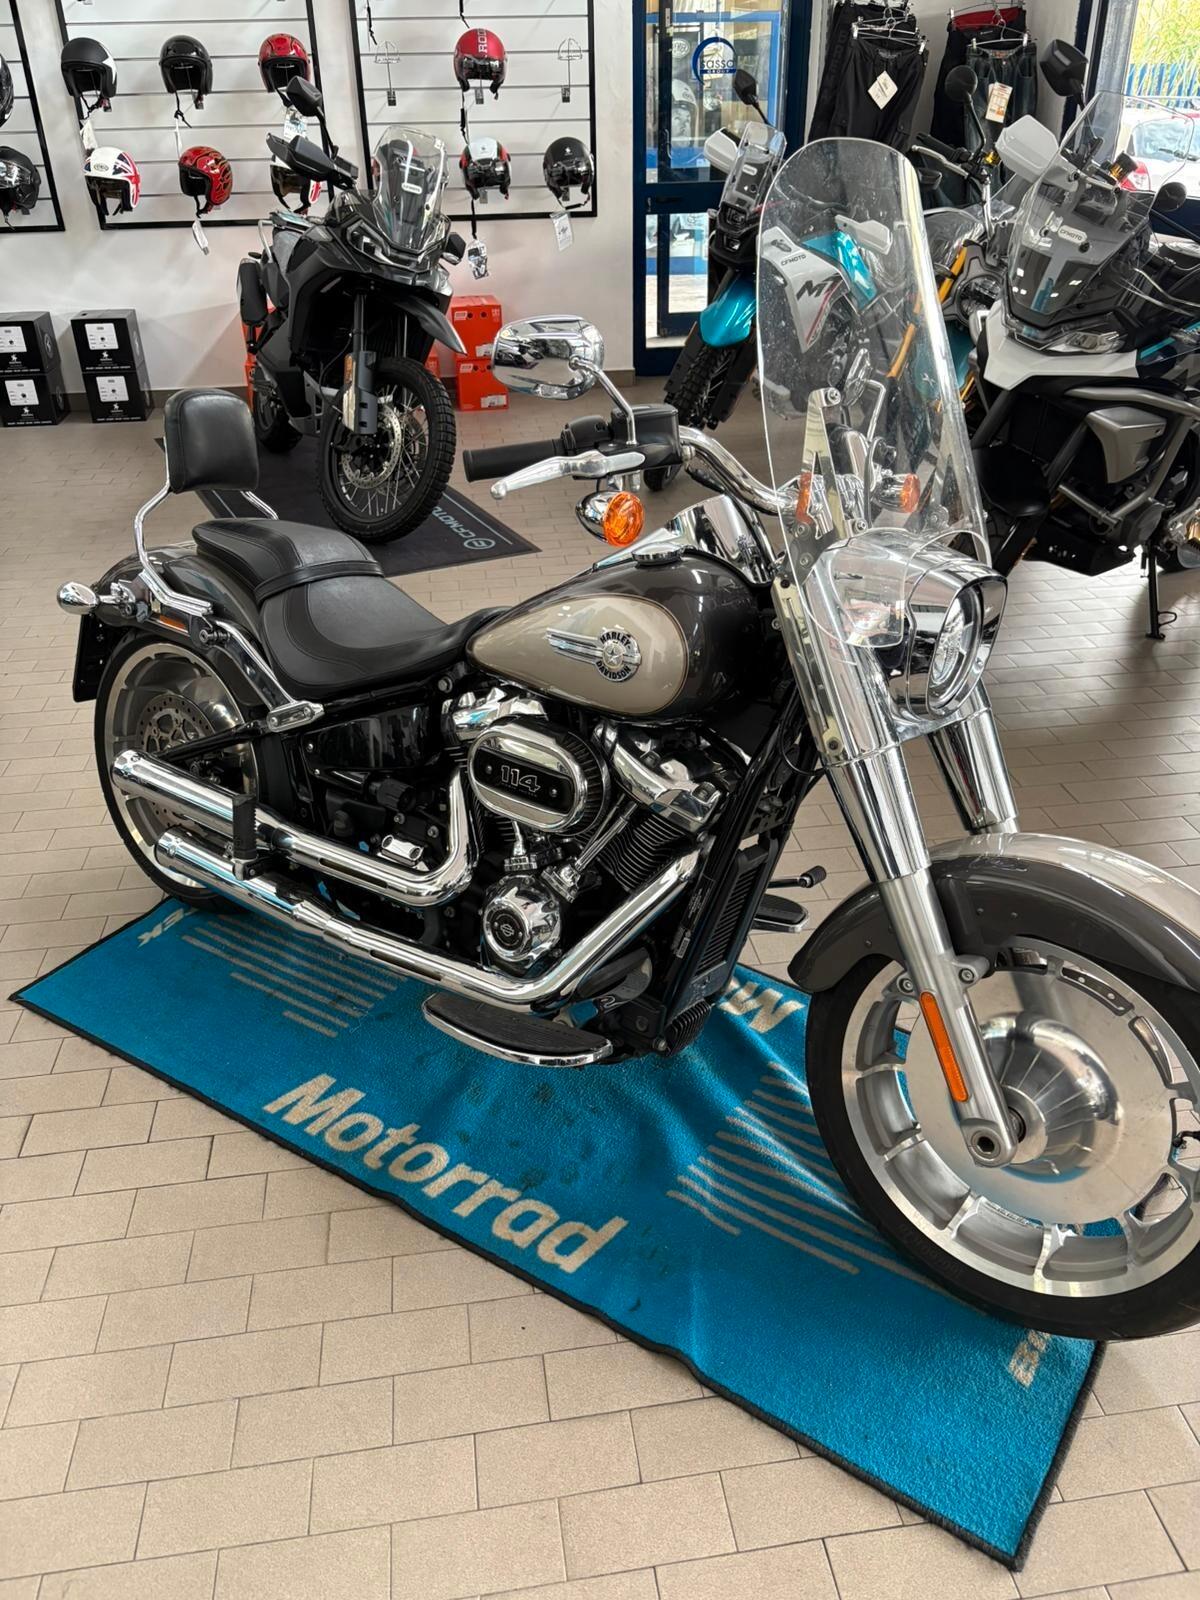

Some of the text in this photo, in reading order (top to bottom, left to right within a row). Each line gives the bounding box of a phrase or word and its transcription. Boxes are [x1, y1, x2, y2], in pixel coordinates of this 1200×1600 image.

[596, 660, 632, 680] DAVIDSON
[501, 765, 541, 793] 114
[263, 1073, 629, 1273] Motorrad
